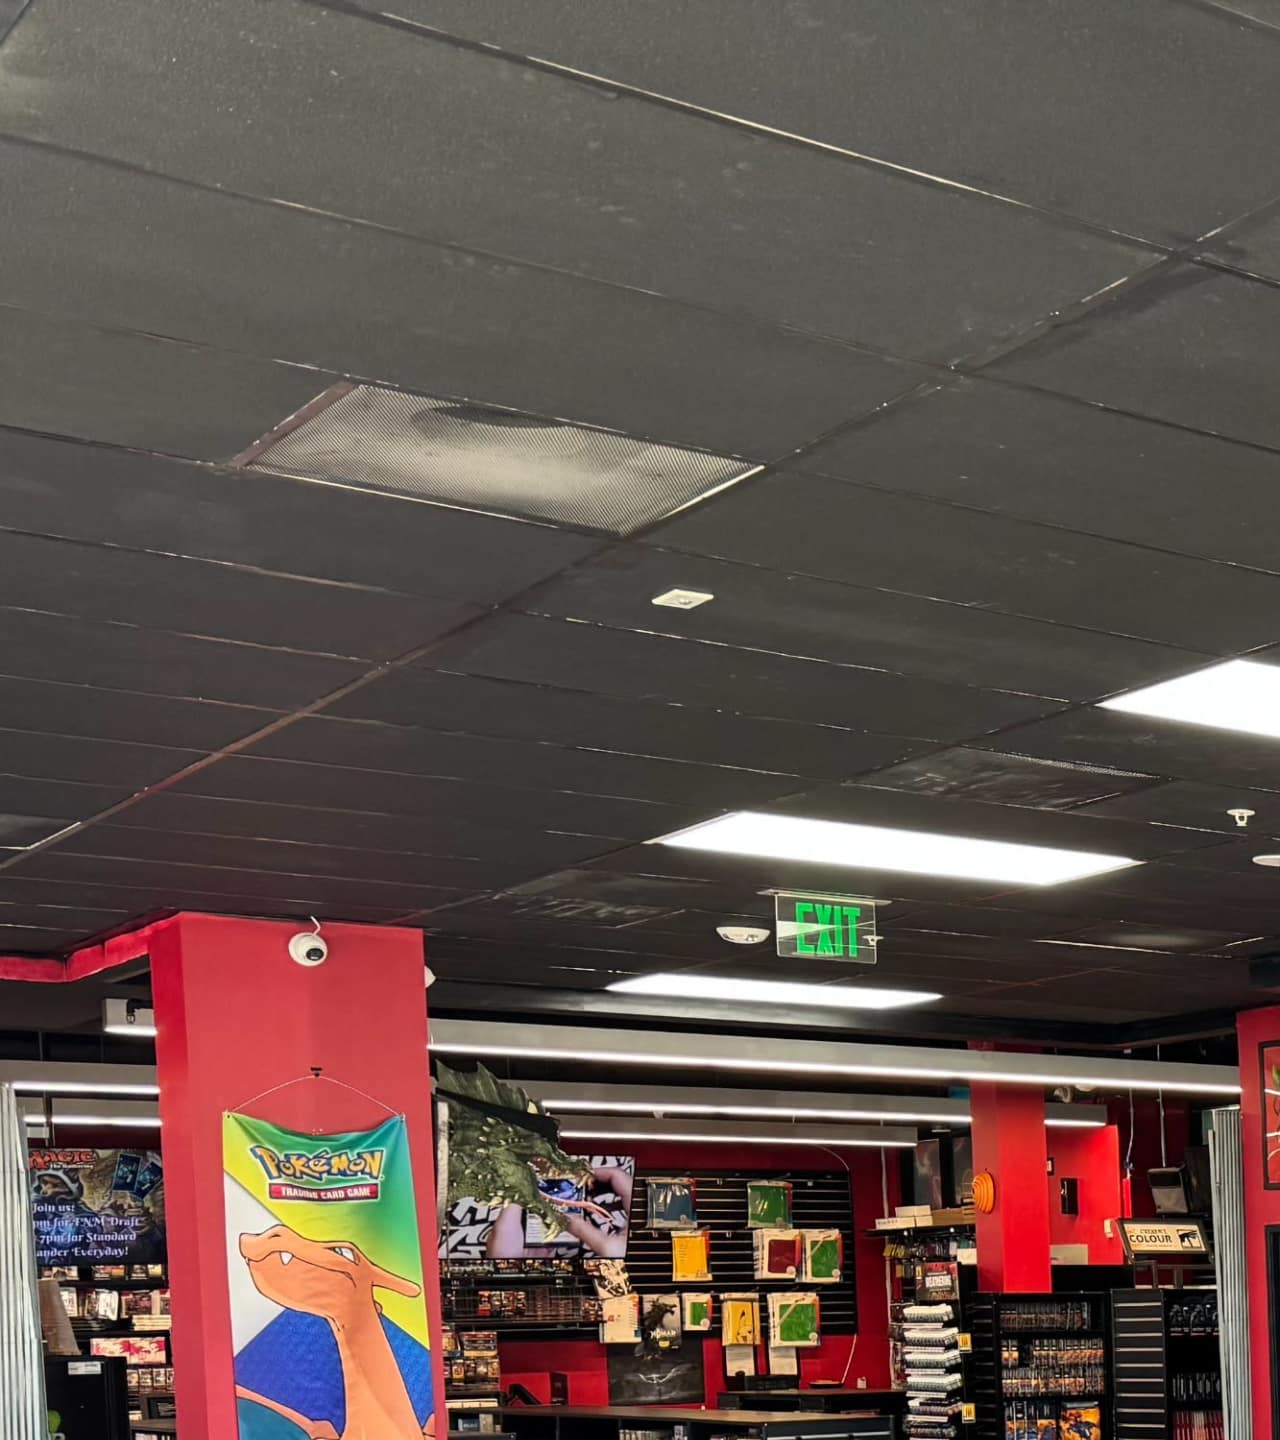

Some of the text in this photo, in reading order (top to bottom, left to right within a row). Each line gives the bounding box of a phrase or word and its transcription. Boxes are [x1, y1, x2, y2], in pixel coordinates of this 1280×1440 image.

[795, 902, 861, 957] EXIT
[281, 1186, 371, 1199] TRADING CARD GAME
[53, 1217, 70, 1229] for
[66, 1232, 84, 1244] for
[86, 1231, 137, 1243] Standard
[1129, 1234, 1173, 1243] COLOUR
[36, 1246, 129, 1259] ander Everyday!
